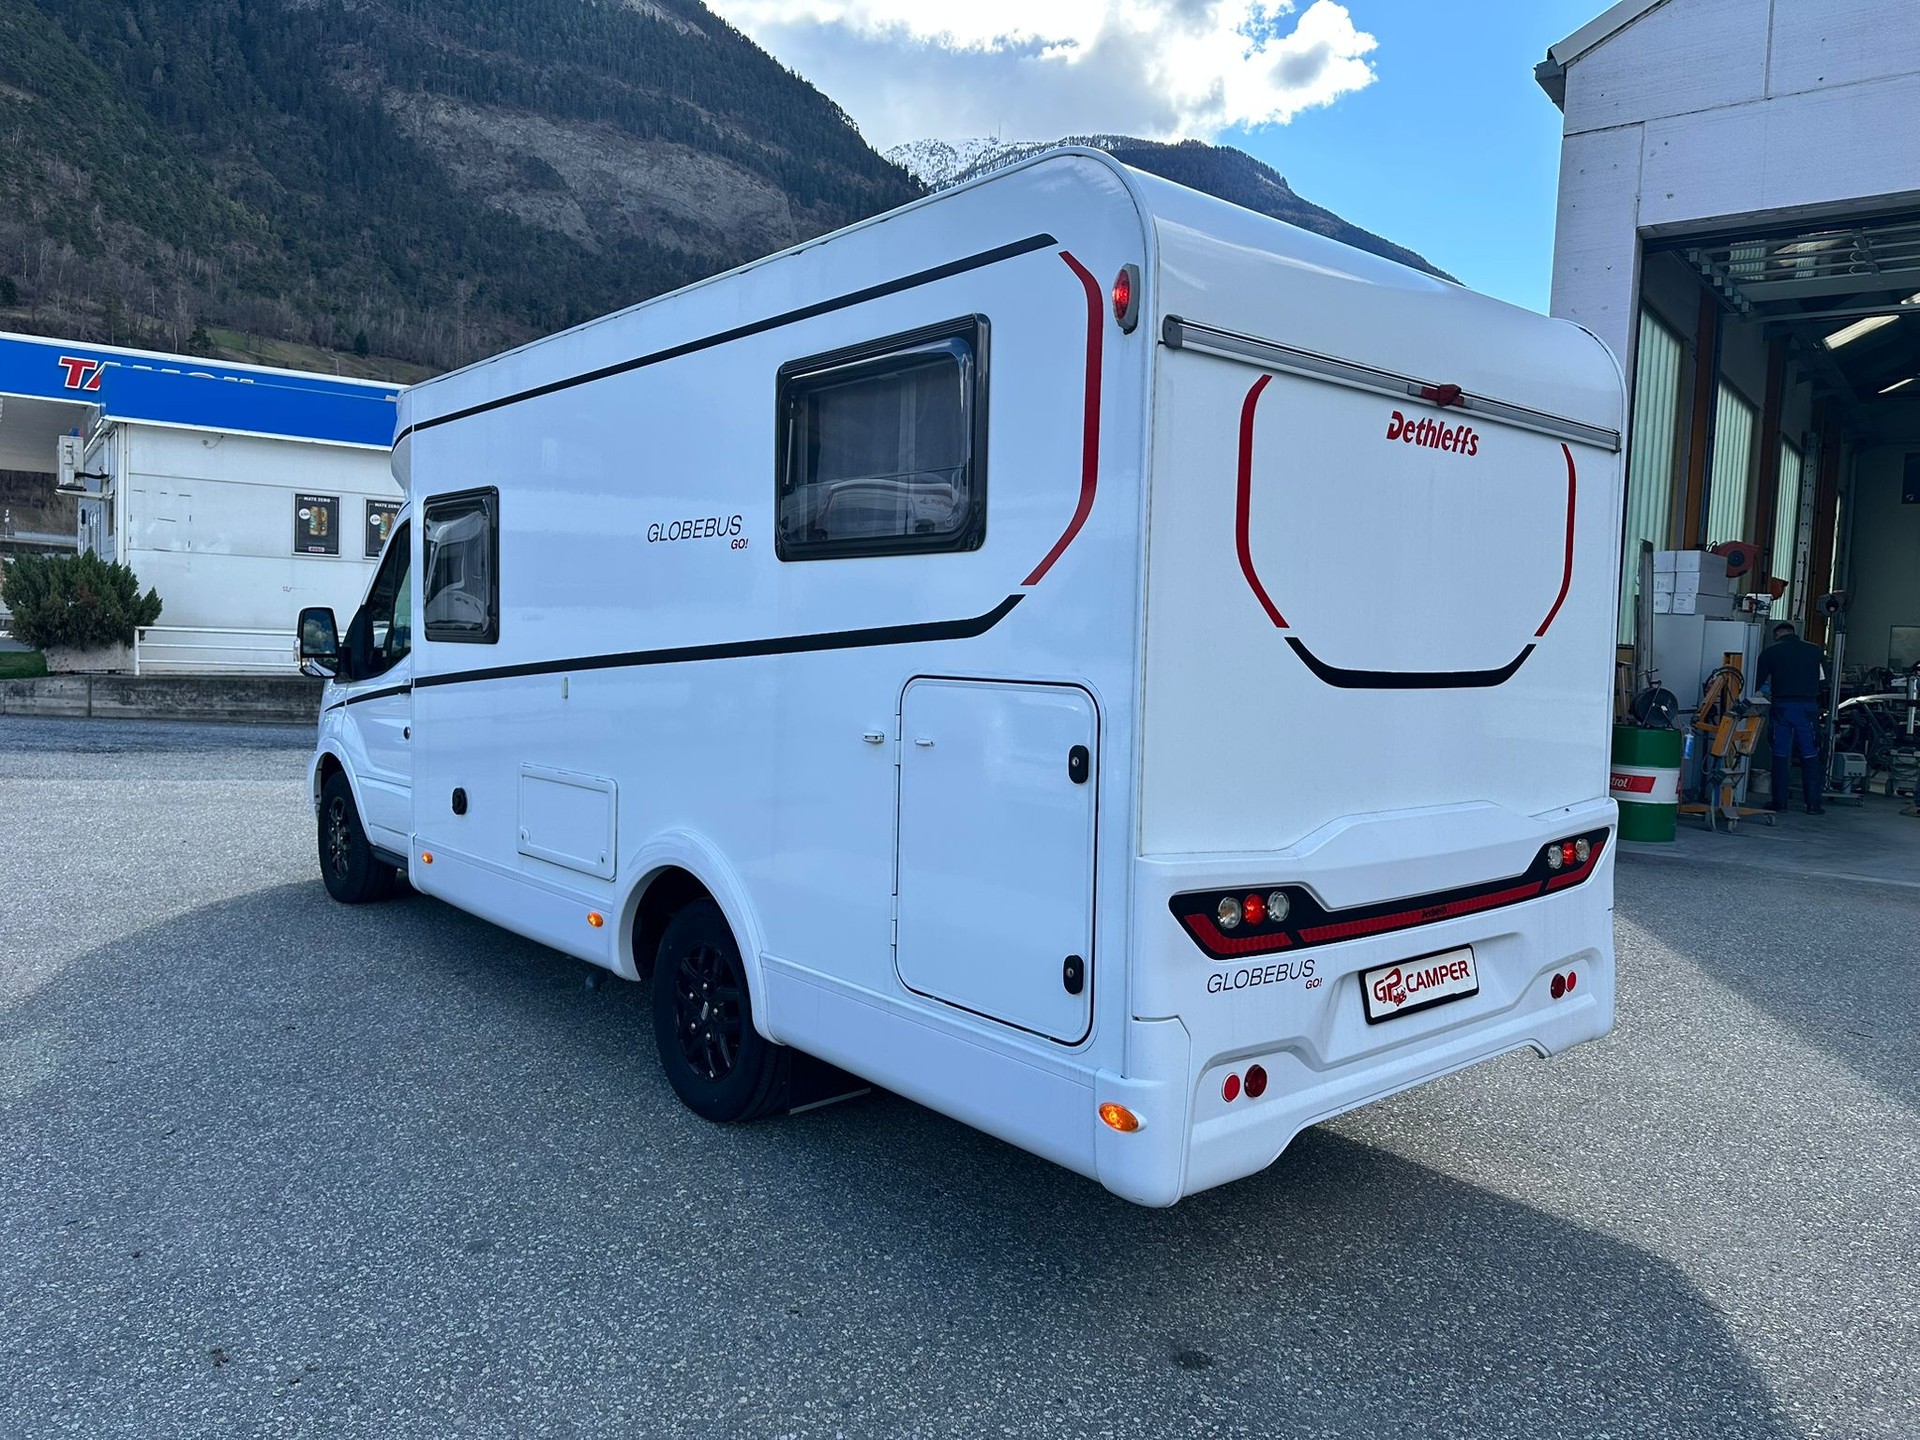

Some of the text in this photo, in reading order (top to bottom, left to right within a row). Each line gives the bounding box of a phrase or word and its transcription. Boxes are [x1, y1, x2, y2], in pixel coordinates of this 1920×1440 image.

[1386, 410, 1480, 457] Dethleffs
[647, 514, 743, 543] GLOBEBUS
[730, 538, 749, 550] GO!
[1206, 959, 1316, 994] GLOBEBUS
[1305, 978, 1323, 990] GO!
[1373, 960, 1471, 1003] GP CAMPER
